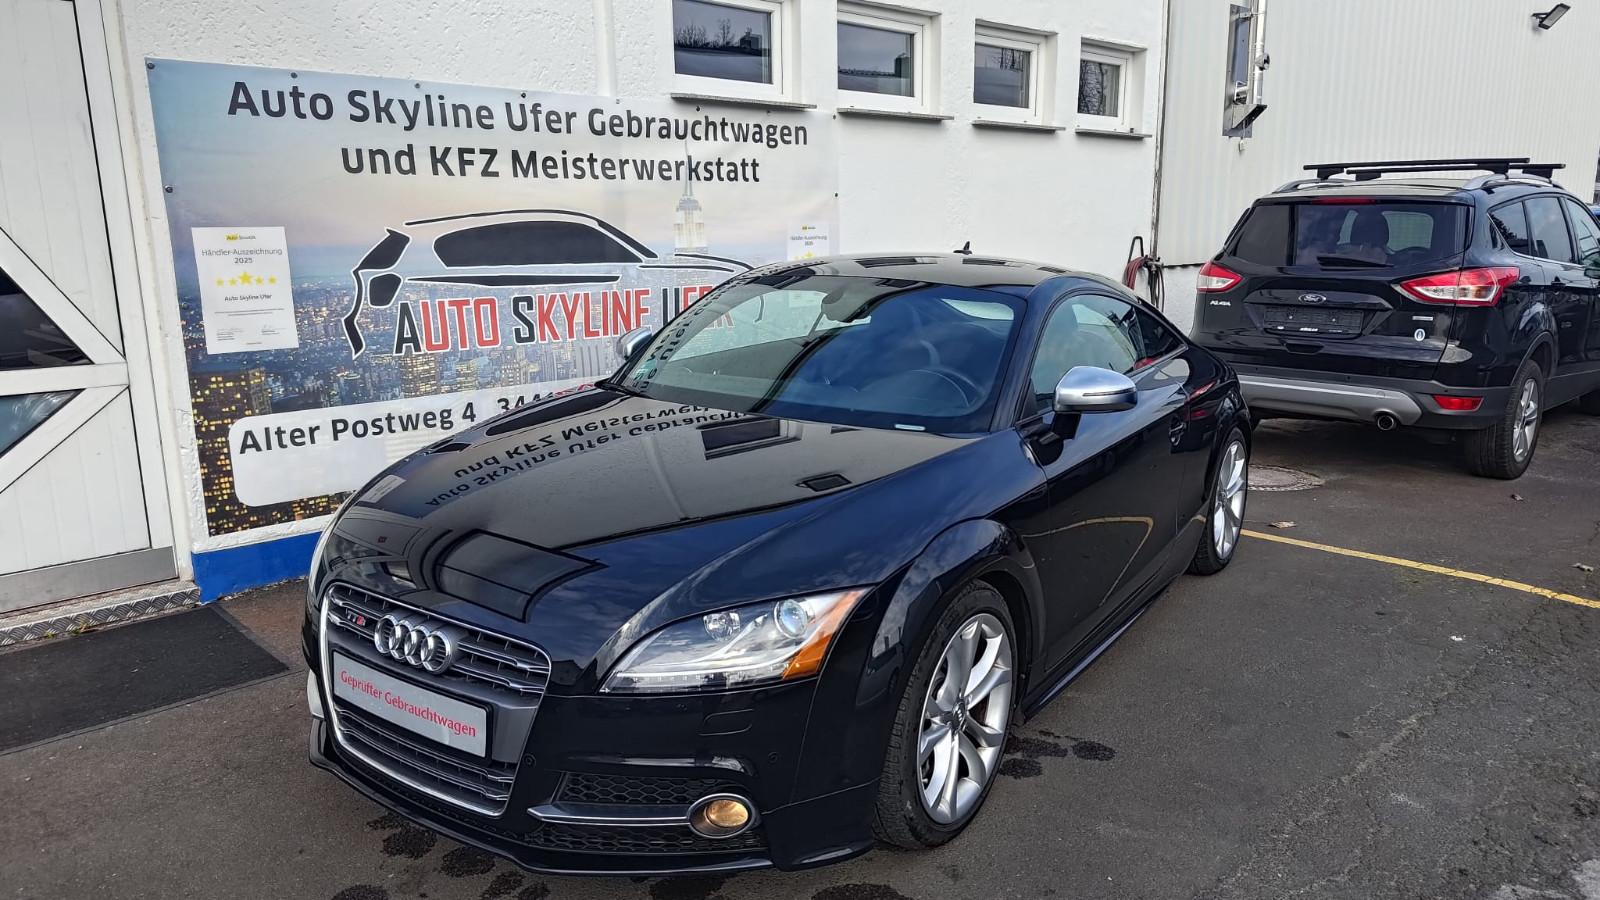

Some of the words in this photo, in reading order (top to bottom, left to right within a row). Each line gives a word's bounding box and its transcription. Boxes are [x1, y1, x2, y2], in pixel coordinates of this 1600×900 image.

[228, 80, 334, 120] Auto
[347, 89, 495, 131] Skyline
[505, 101, 577, 134] Ufer
[588, 108, 808, 149] Gebrauchtwagen
[341, 144, 417, 175] und
[429, 145, 500, 178] KFZ
[511, 150, 760, 183] Meisterwerkstatt
[201, 247, 283, 257] Händler-Auszeichnung
[394, 297, 500, 355] AUTO
[512, 288, 650, 344] SKYLINE
[240, 424, 320, 455] Alter
[331, 408, 454, 442] Postweg
[461, 402, 477, 423] 4
[340, 671, 383, 701] Geprüfter
[384, 691, 477, 738] Gebrauchtwagen
